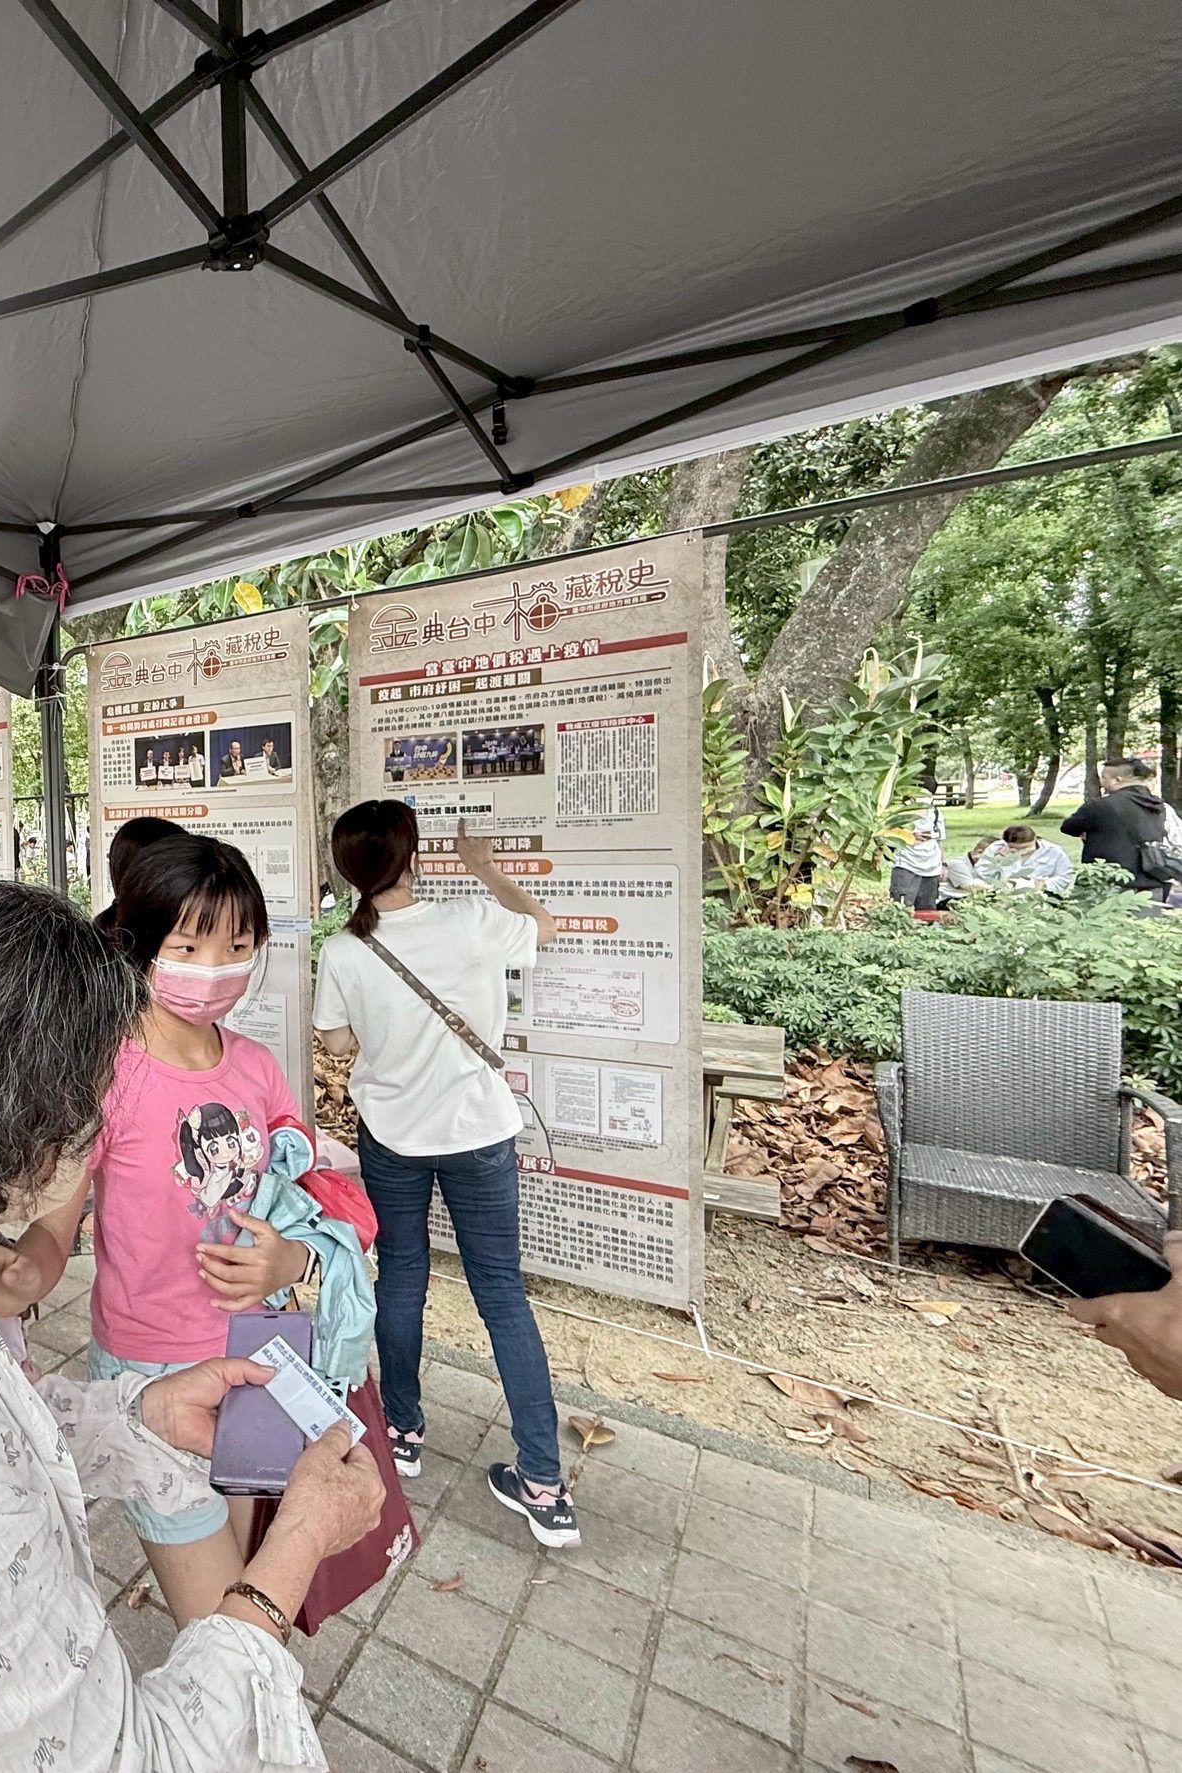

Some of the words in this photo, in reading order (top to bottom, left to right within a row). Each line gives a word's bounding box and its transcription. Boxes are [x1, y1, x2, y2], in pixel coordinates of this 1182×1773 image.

[425, 638, 601, 677] 當臺中地價稅遇上疫情
[378, 687, 402, 702] 疫起
[409, 671, 531, 698] 市府紓困一起渡難關
[393, 1446, 412, 1456] FILA
[552, 1514, 573, 1524] FILA
